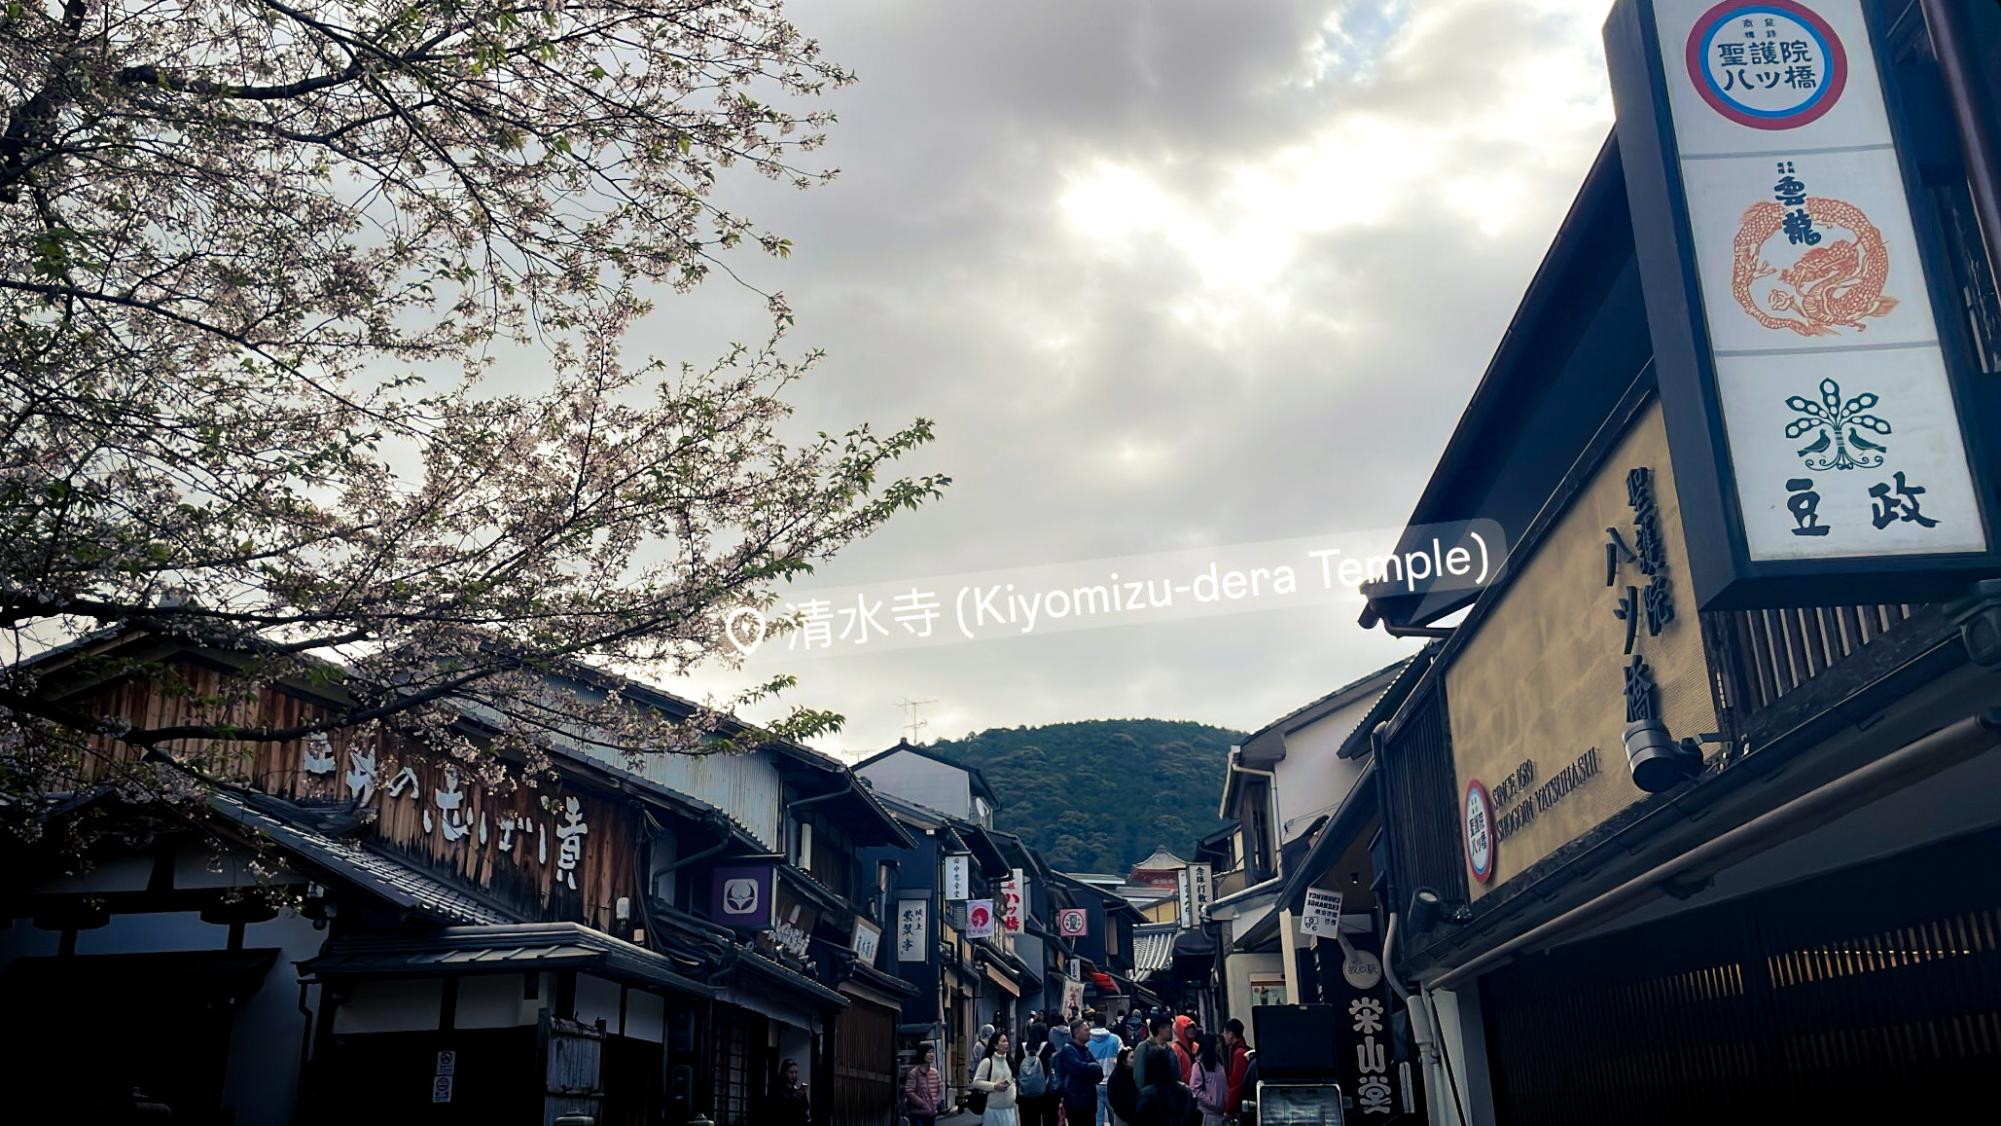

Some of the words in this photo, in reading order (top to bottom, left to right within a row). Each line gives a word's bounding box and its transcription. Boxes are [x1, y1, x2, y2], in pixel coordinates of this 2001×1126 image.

[1717, 39, 1812, 67] 聖護院
[1723, 65, 1817, 91] 八ツ橋
[1774, 176, 1822, 246] 雲龍
[1785, 470, 1941, 539] 豆政
[1627, 466, 1676, 636] 聖護院
[1492, 773, 1517, 810] SINCE
[1496, 796, 1534, 843] SHOGOIN
[1535, 746, 1599, 813] YATSUHASHI
